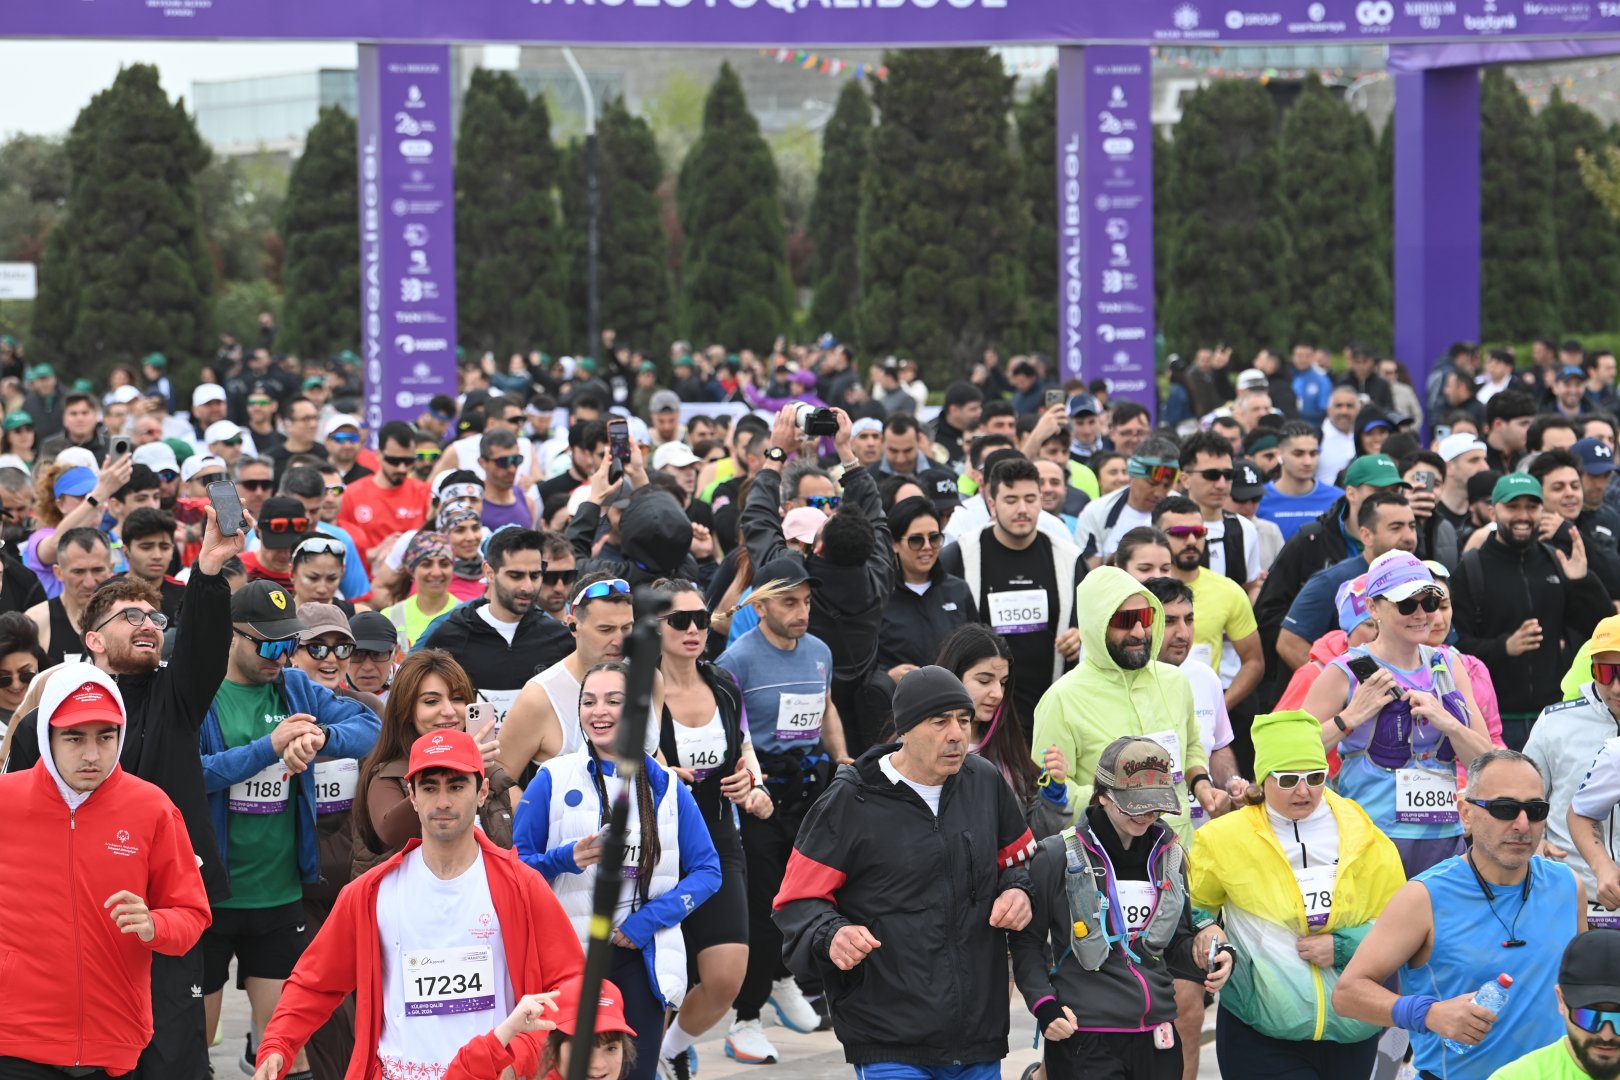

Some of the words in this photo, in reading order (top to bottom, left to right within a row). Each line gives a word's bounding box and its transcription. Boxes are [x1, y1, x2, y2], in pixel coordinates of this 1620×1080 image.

[997, 607, 1042, 622] 13505
[790, 712, 821, 727] 4577
[689, 750, 718, 767] 146
[245, 781, 282, 798] 1188
[1405, 790, 1454, 807] 16884
[414, 972, 483, 997] 17234
